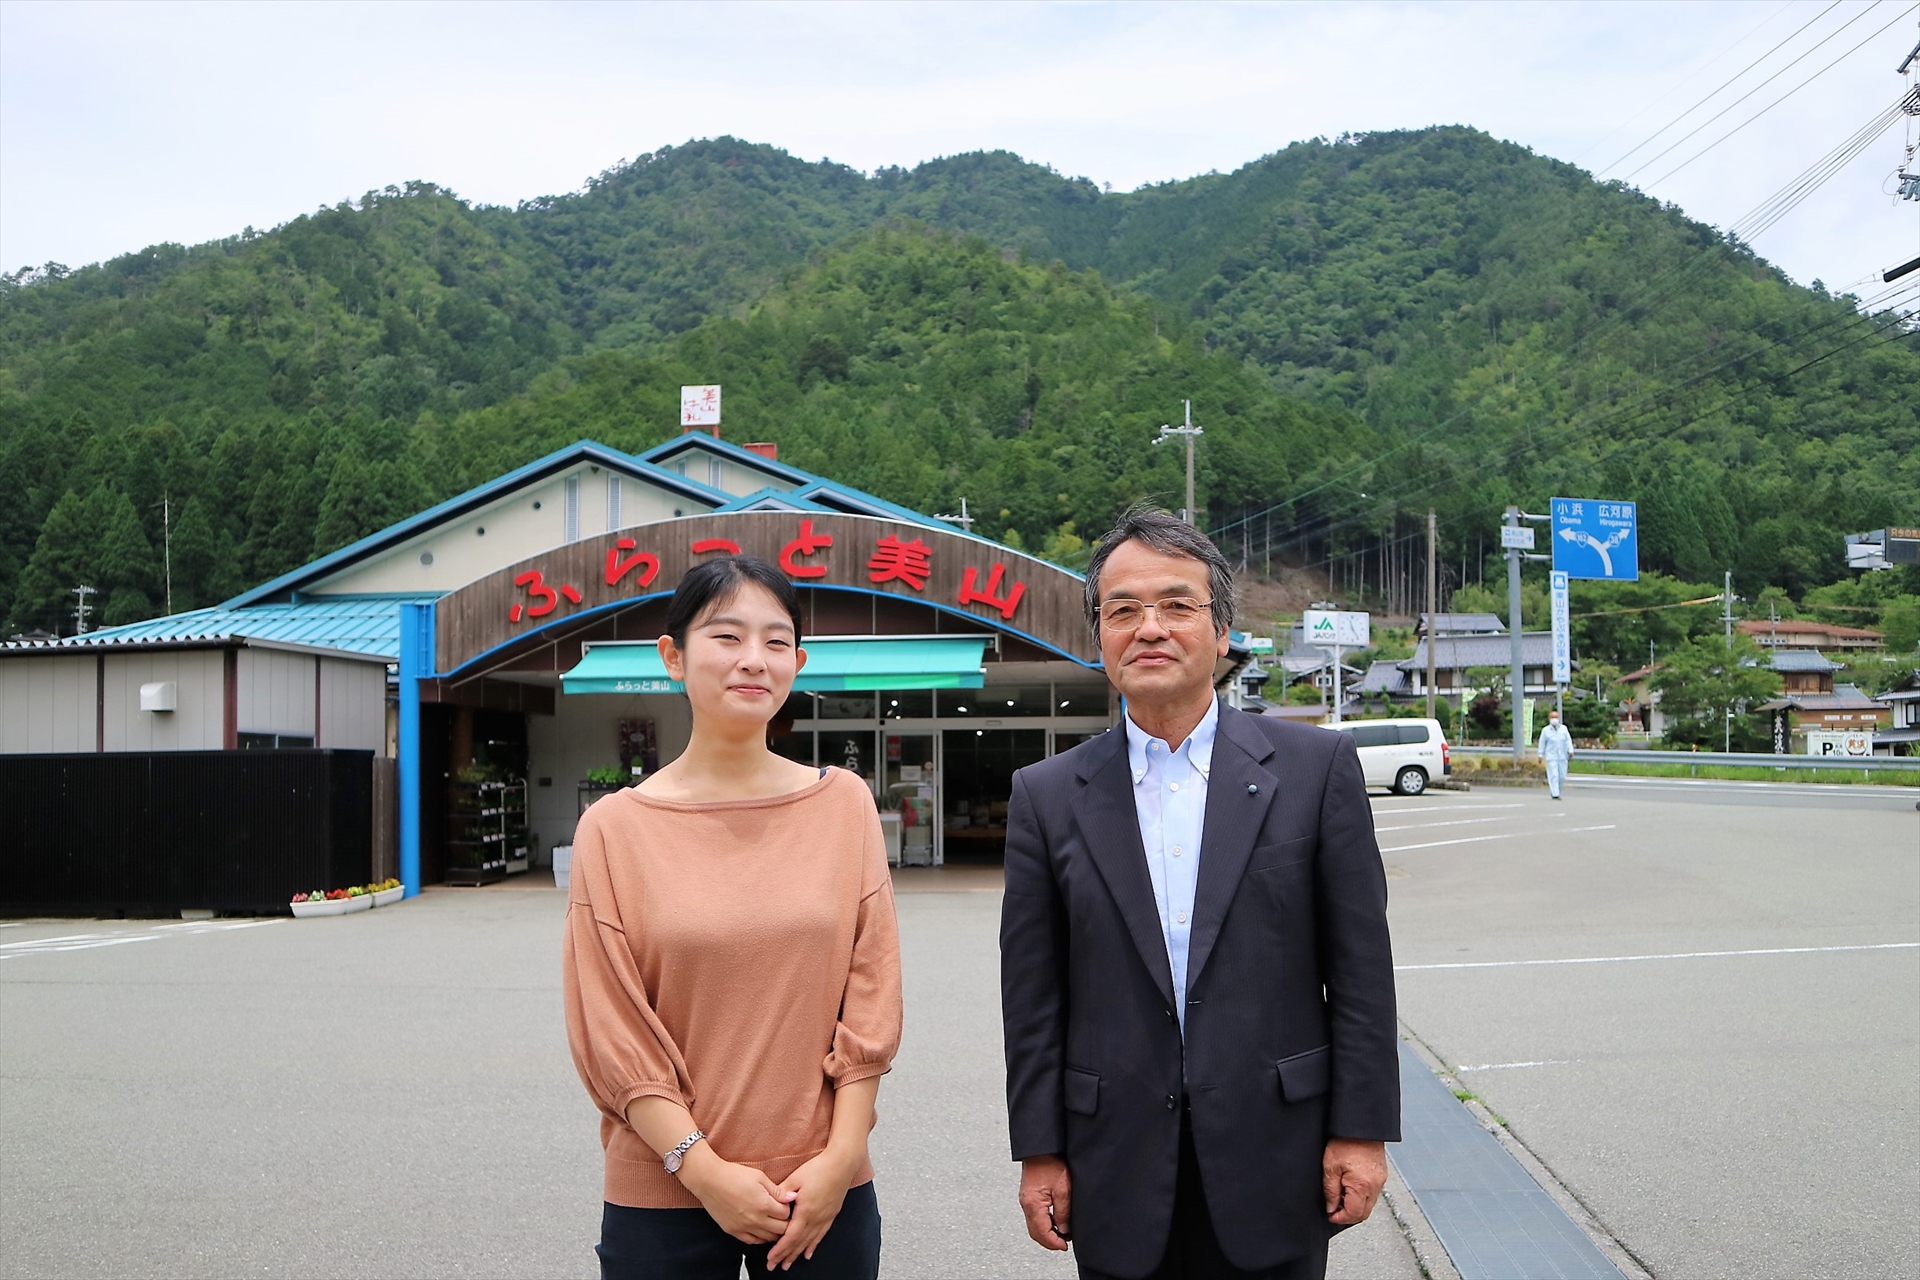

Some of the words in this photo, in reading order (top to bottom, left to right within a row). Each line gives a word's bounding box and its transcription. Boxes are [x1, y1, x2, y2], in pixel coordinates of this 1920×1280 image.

[1557, 502, 1584, 516] 小浜
[1598, 504, 1633, 519] 広河原
[1560, 515, 1582, 525] Obama
[1576, 533, 1588, 541] 162
[1610, 534, 1619, 545] 38
[615, 681, 670, 691] ふらっと美山
